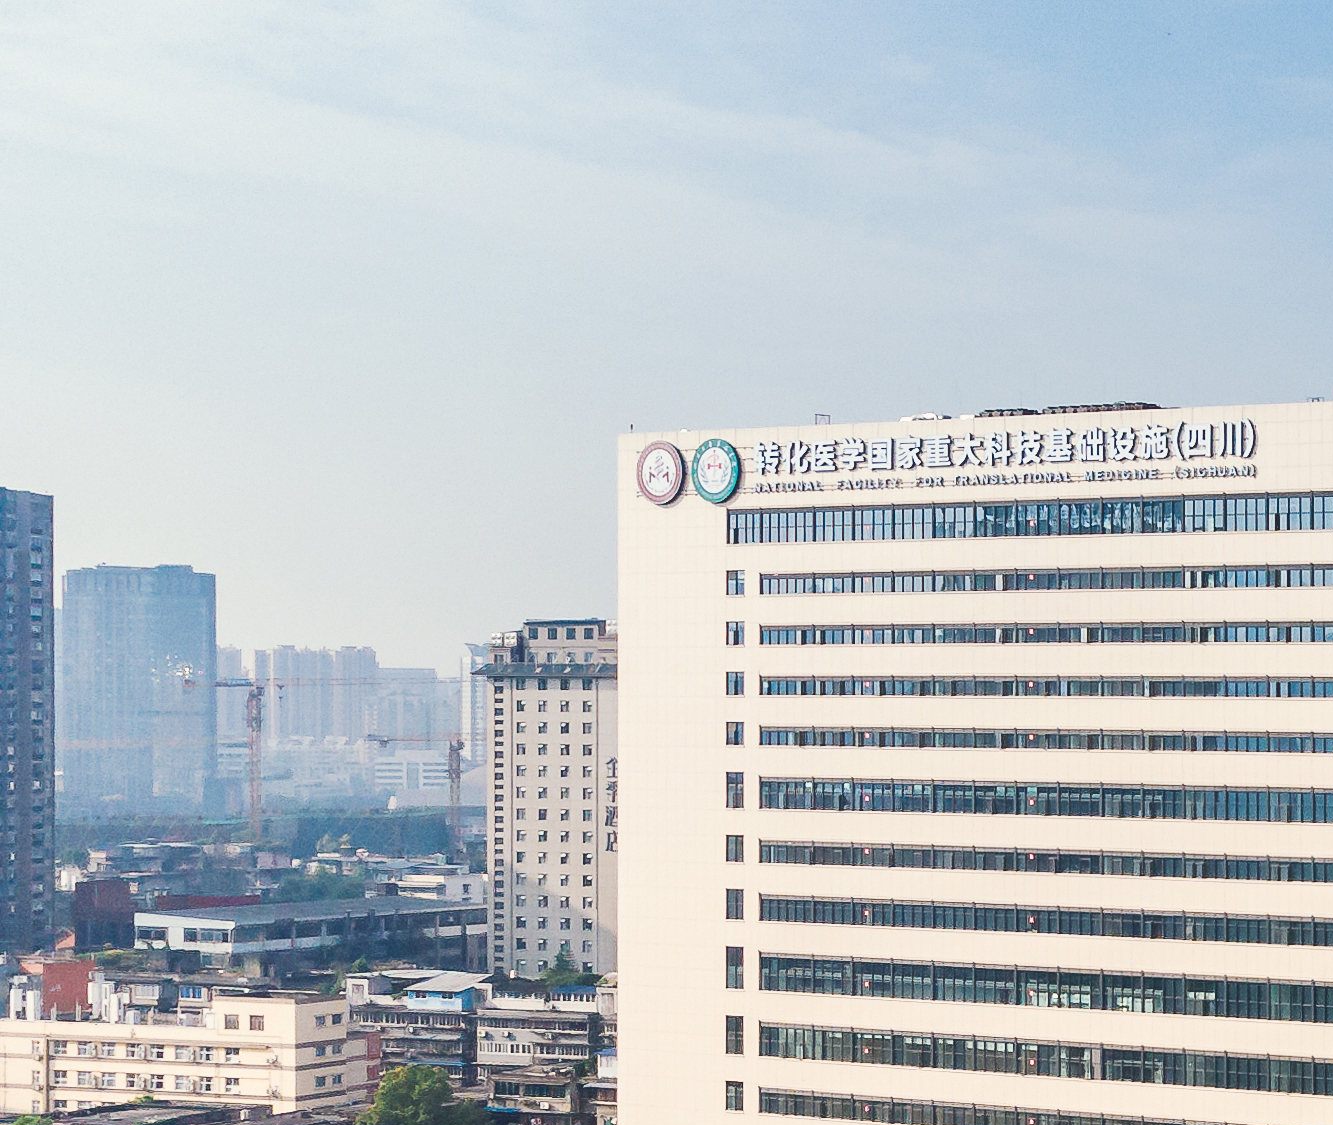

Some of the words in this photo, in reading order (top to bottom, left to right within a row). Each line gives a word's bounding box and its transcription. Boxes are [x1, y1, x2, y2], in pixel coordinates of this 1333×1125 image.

[756, 481, 822, 493] NATIONAL
[837, 478, 901, 490] FACILITY
[915, 475, 944, 487] FOR
[955, 471, 1071, 485] TRANSLATIONAL
[1083, 468, 1160, 481] MEDICINE
